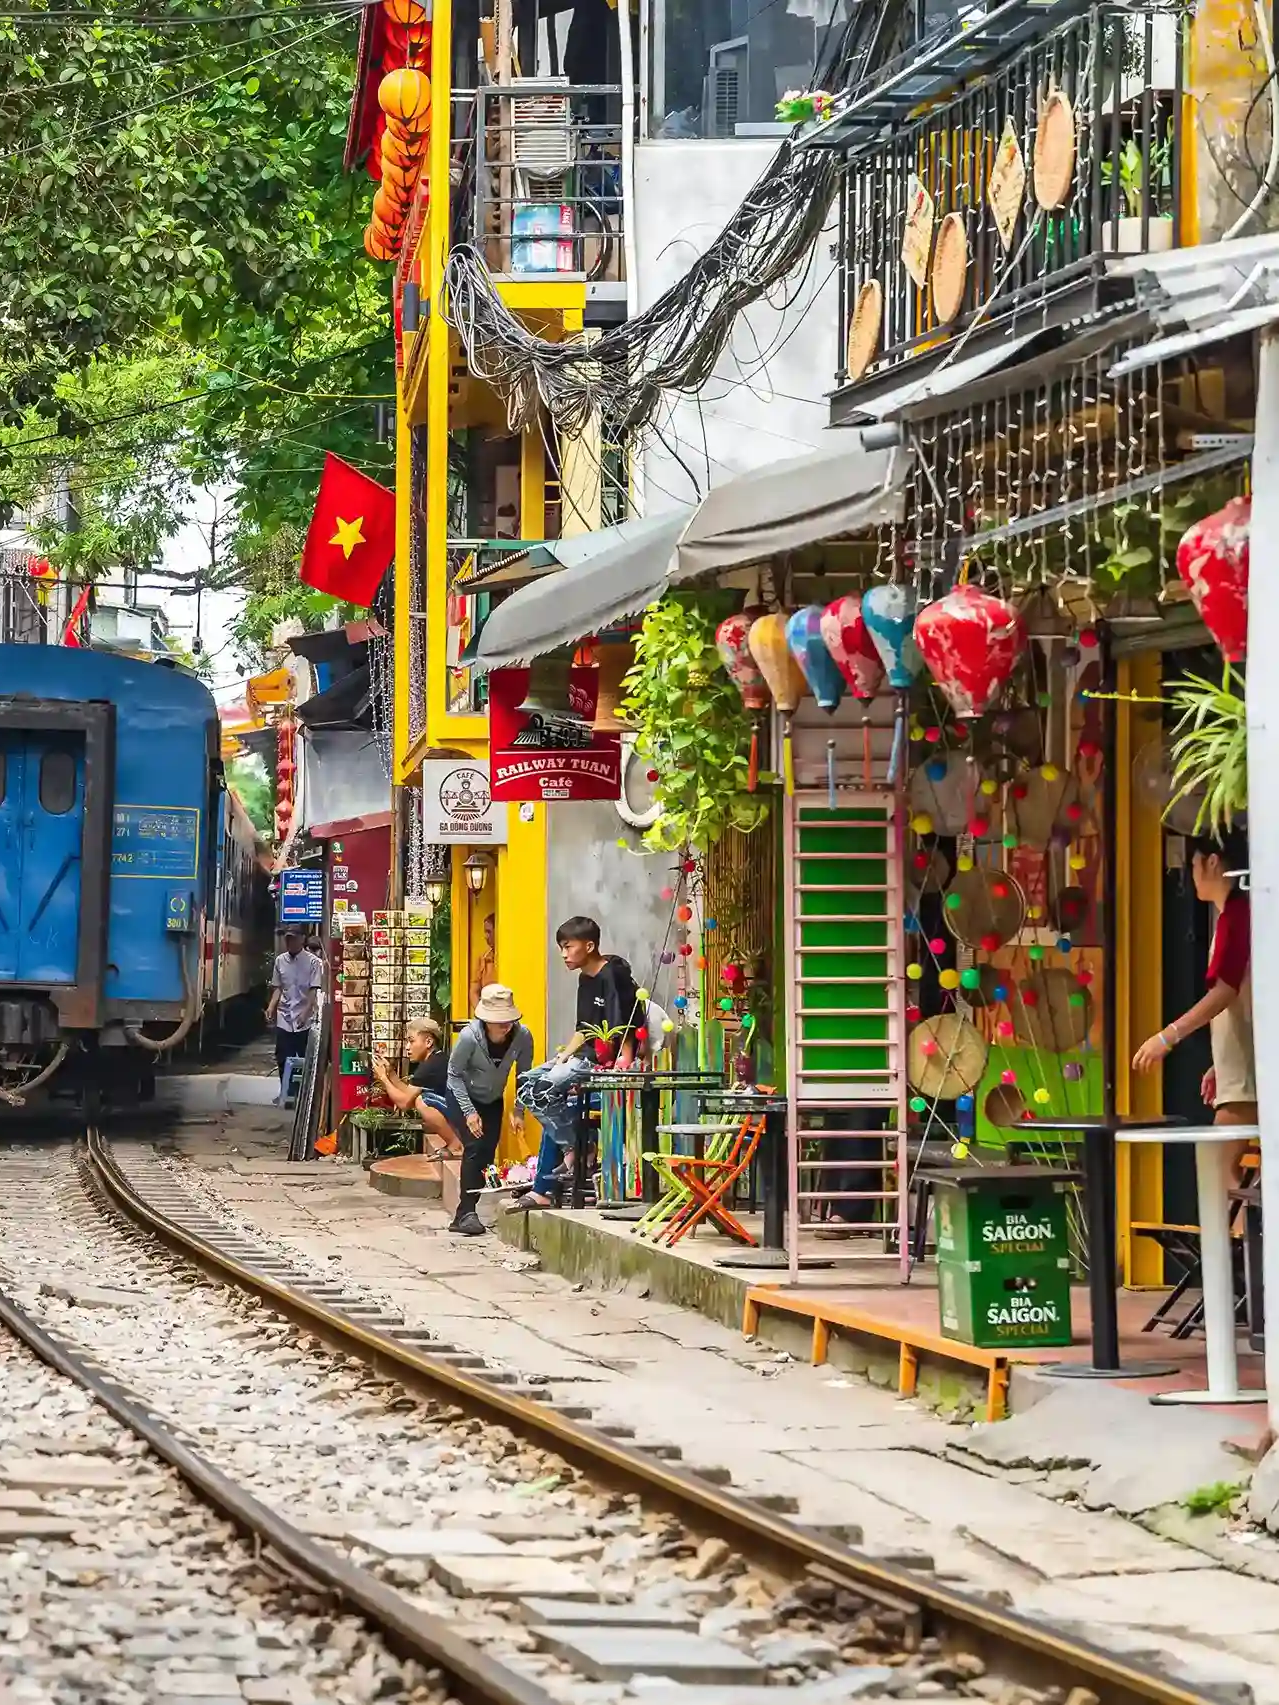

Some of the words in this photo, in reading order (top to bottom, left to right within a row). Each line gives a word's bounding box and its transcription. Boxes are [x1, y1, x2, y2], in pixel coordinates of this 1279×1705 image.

[496, 758, 566, 779] RAILWAY
[570, 758, 611, 775] TUAN
[456, 771, 475, 780] CAFÉ
[538, 776, 574, 788] Café
[1006, 1214, 1028, 1225] BIA
[982, 1223, 1052, 1242] SAIGON
[990, 1242, 1046, 1254] SPECIAL
[1010, 1297, 1033, 1308] BIA
[987, 1306, 1057, 1325] SAIGON
[996, 1324, 1050, 1337] SPECIAL
